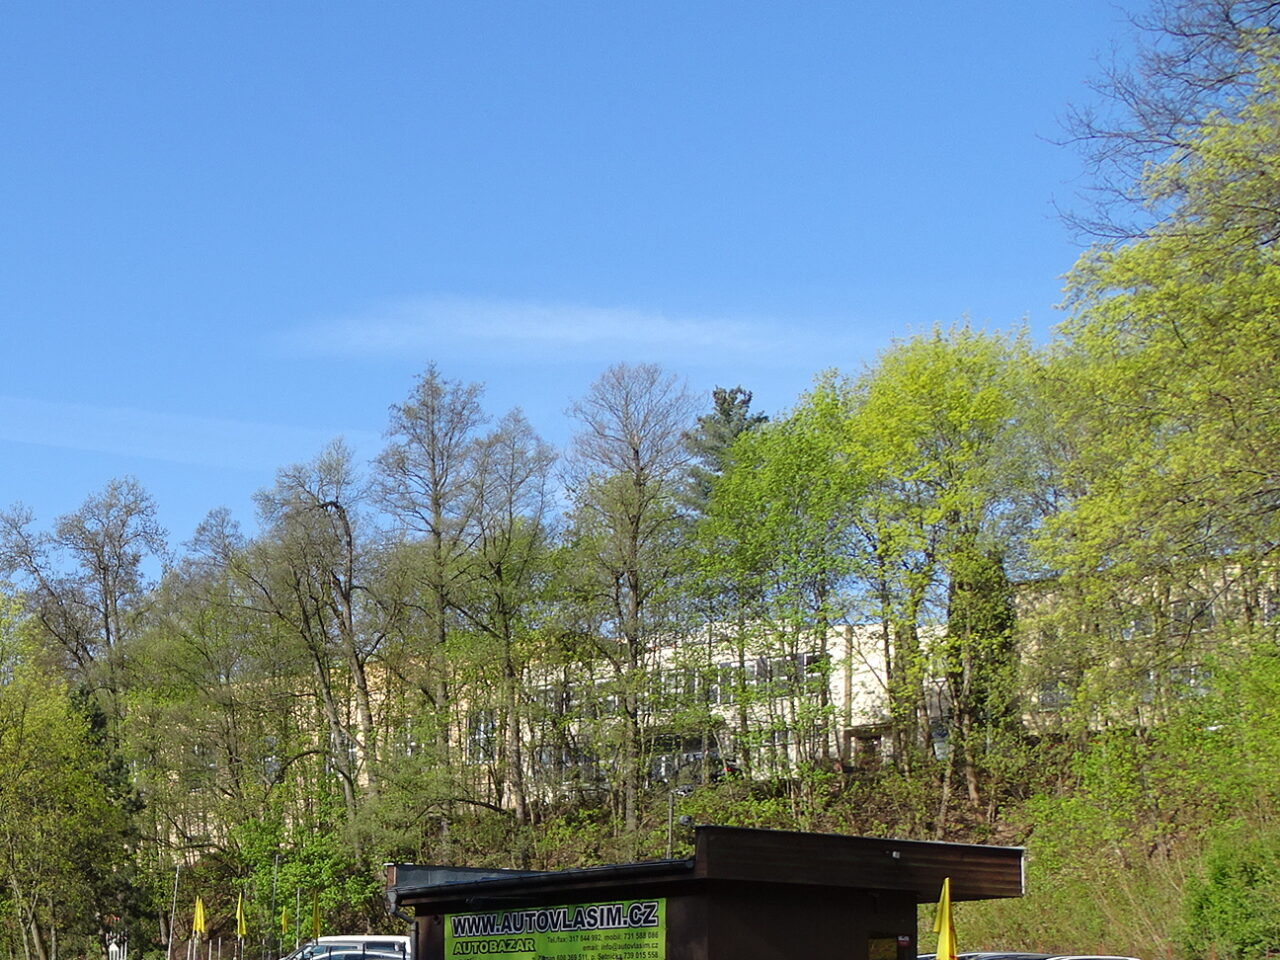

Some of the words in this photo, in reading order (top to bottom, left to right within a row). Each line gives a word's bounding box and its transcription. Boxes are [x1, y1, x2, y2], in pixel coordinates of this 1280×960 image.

[451, 901, 660, 938] WWW.AUTOVLASIM.CZ
[624, 932, 634, 940] 731
[453, 938, 537, 955] AUTOBAZAR
